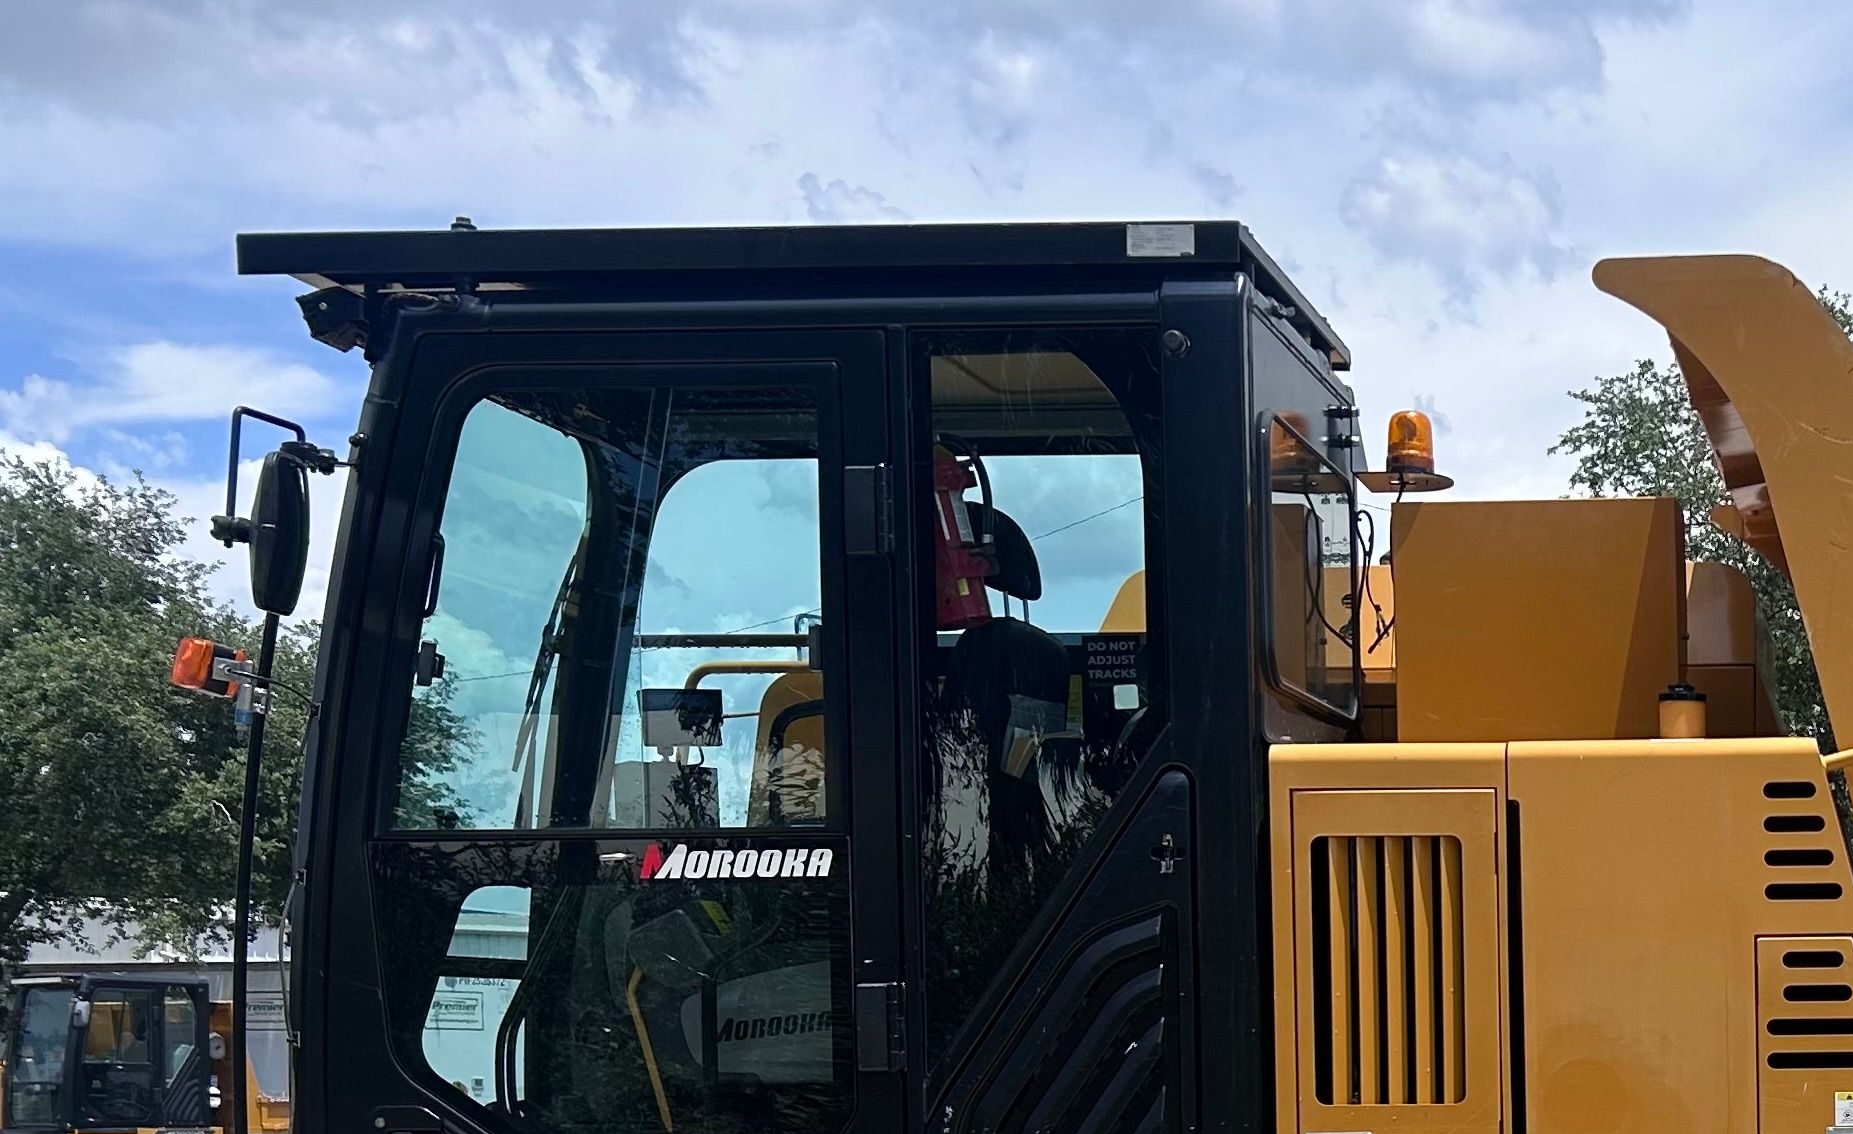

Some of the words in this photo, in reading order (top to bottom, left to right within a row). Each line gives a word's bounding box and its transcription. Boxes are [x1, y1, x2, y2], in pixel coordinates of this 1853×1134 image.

[1088, 641, 1106, 651] DO
[1110, 641, 1135, 650] NOT
[1088, 655, 1136, 665] ADJUST
[1088, 669, 1137, 679] TRACKS
[639, 843, 833, 880] MOROOKA
